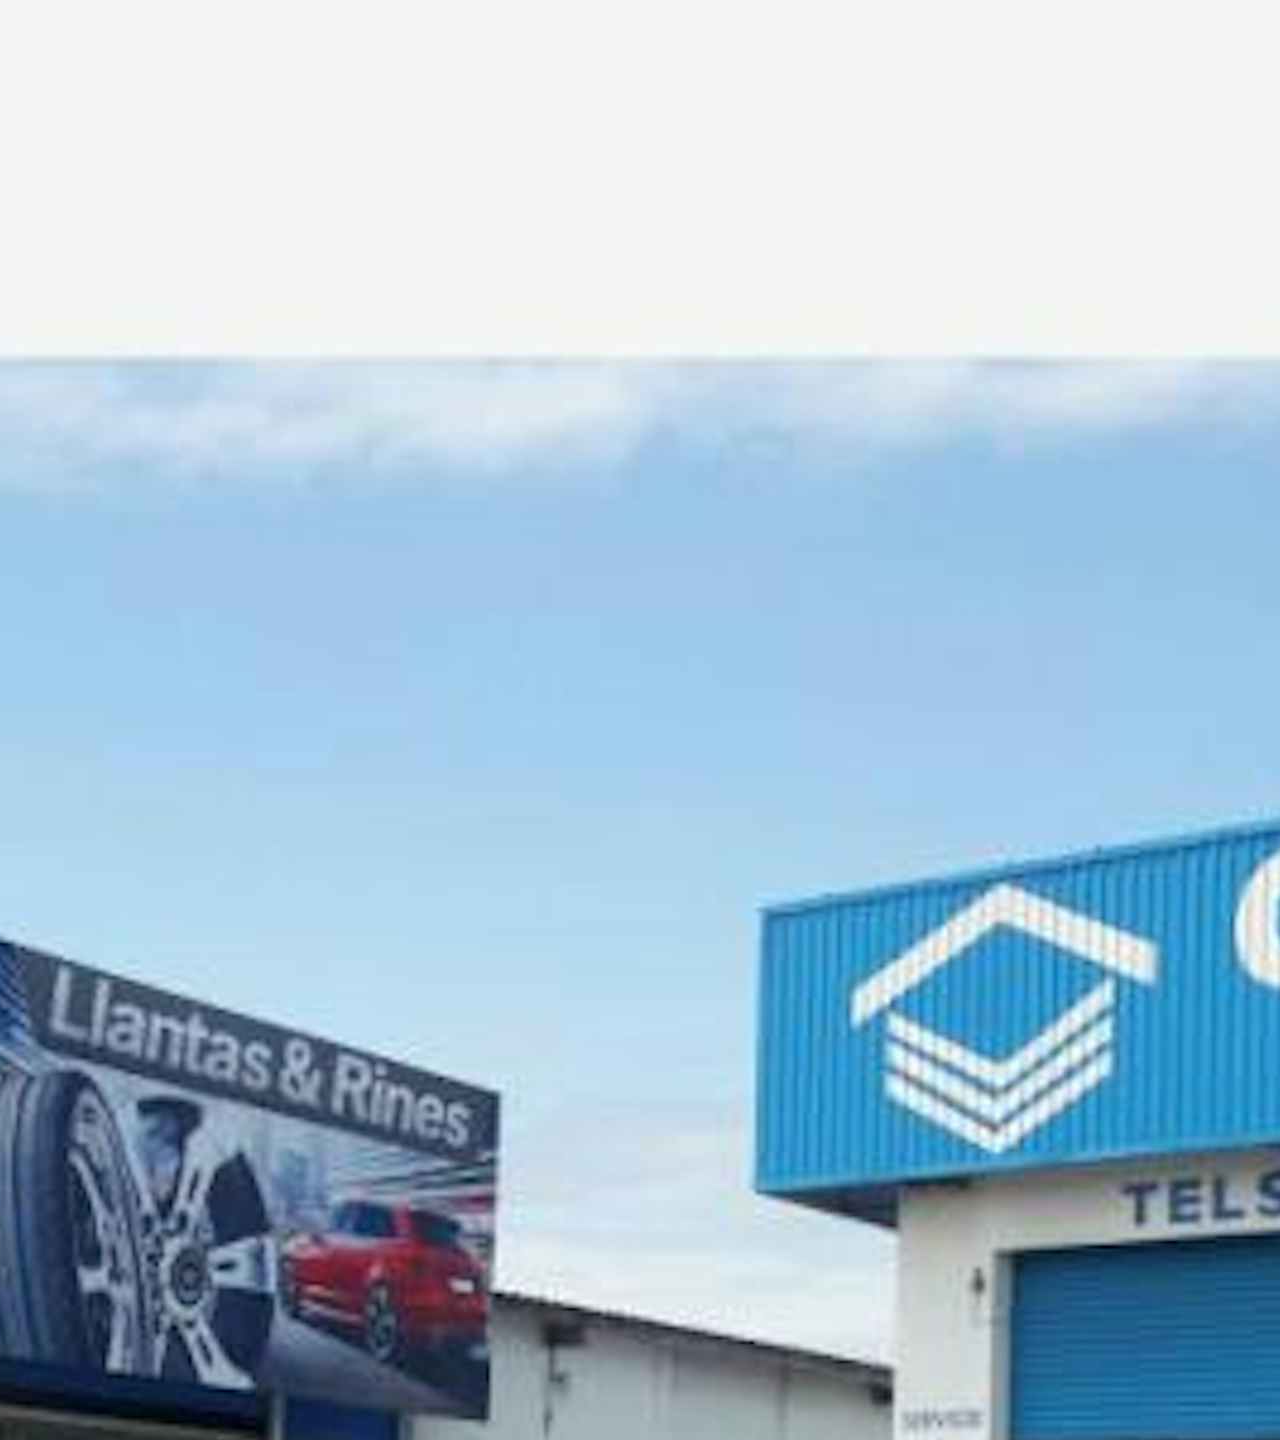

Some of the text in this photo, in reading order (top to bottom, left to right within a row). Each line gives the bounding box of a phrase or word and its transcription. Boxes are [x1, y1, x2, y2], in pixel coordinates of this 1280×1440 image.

[49, 964, 472, 1147] Llantas & Rines
